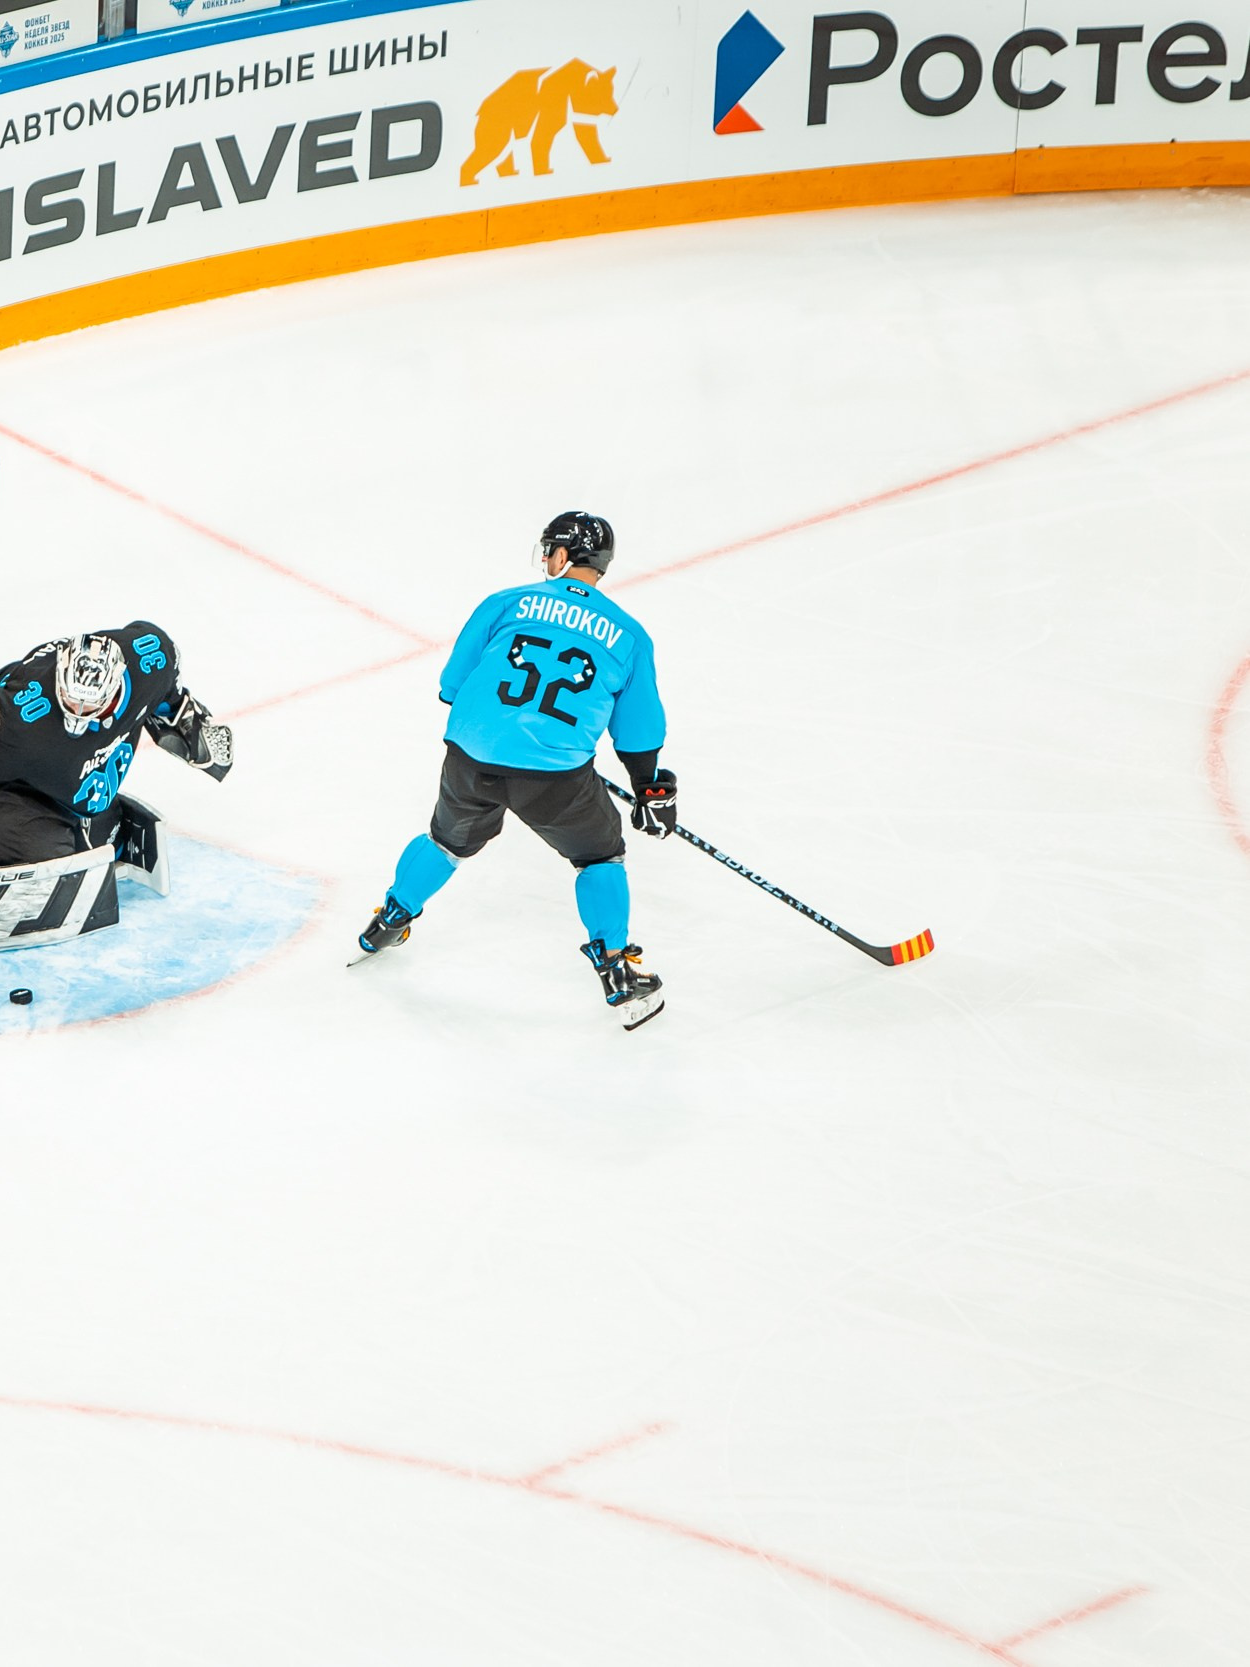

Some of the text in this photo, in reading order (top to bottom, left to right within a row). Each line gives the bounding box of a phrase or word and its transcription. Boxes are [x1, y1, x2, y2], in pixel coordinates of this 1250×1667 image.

[24, 14, 50, 28] ФОНБЕТ
[24, 20, 70, 39] НЕДЕЛЯ ЗВЕЗД
[24, 32, 65, 50] ХОККЕЯ 2025
[0, 29, 448, 149] АВТОМОБИЛЬНЫЕ ШИНЫ
[807, 10, 1250, 126] Росте
[515, 595, 623, 650] SHIROKOV
[132, 633, 167, 675] 30
[13, 680, 52, 724] 30
[497, 633, 598, 727] 52
